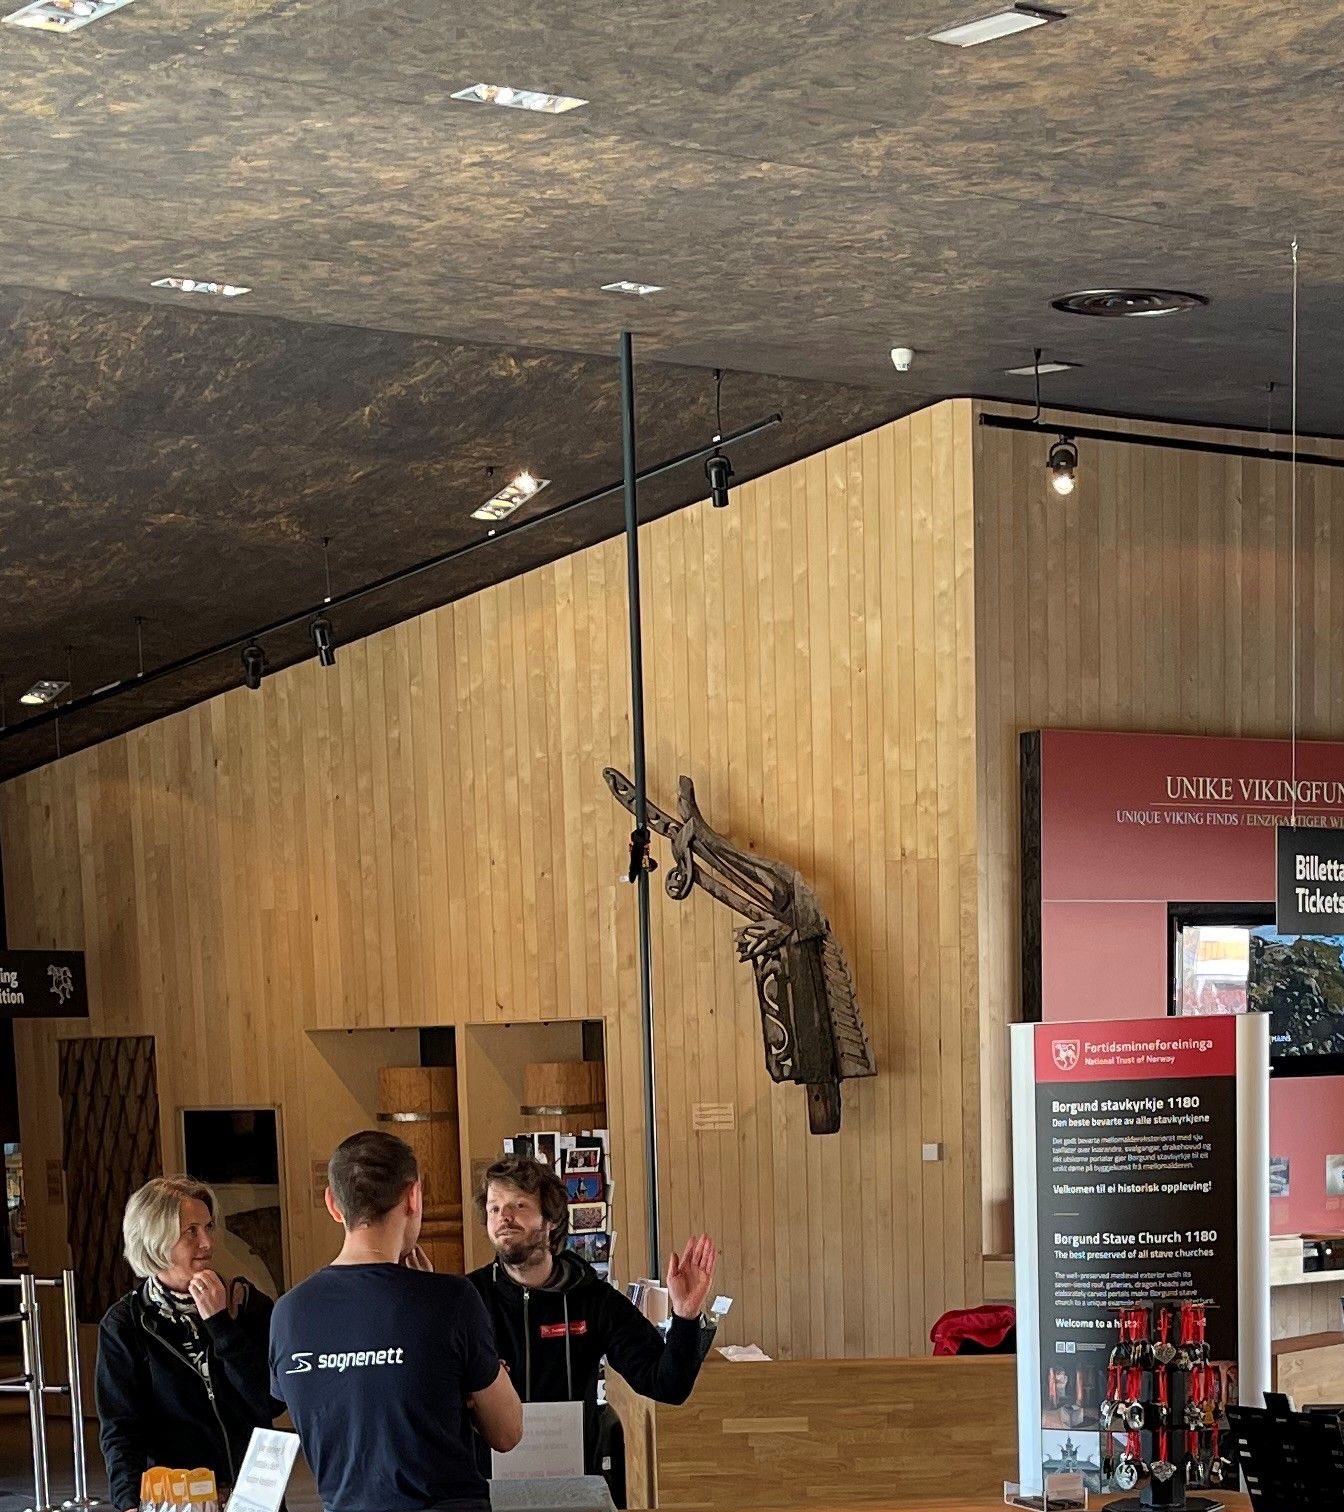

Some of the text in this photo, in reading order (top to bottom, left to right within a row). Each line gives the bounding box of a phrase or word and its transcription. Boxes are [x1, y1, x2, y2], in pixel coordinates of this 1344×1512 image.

[1166, 776, 1233, 801] UNIKE
[1116, 810, 1161, 825] UNIQUE
[1164, 811, 1204, 825] VIKING
[1207, 812, 1238, 826] FINDS
[1084, 1038, 1213, 1053] Fortidsminneforeininga
[1084, 1055, 1176, 1066] National Trust of Norway
[1052, 1096, 1200, 1115] Borgund stavkyrkje 1180
[1052, 1114, 1210, 1127] Den beste bevarte av alle stavkyrkjene
[1053, 1181, 1212, 1195] Velkomen til ei historisk oppleving!
[1054, 1230, 1218, 1247] Borgund Stave Church 1180
[1054, 1248, 1214, 1260] The best preserved of all stave churches
[1056, 1319, 1094, 1329] Welcome
[1095, 1319, 1105, 1328] to
[1106, 1320, 1112, 1328] a
[317, 1347, 404, 1372] sognenett
